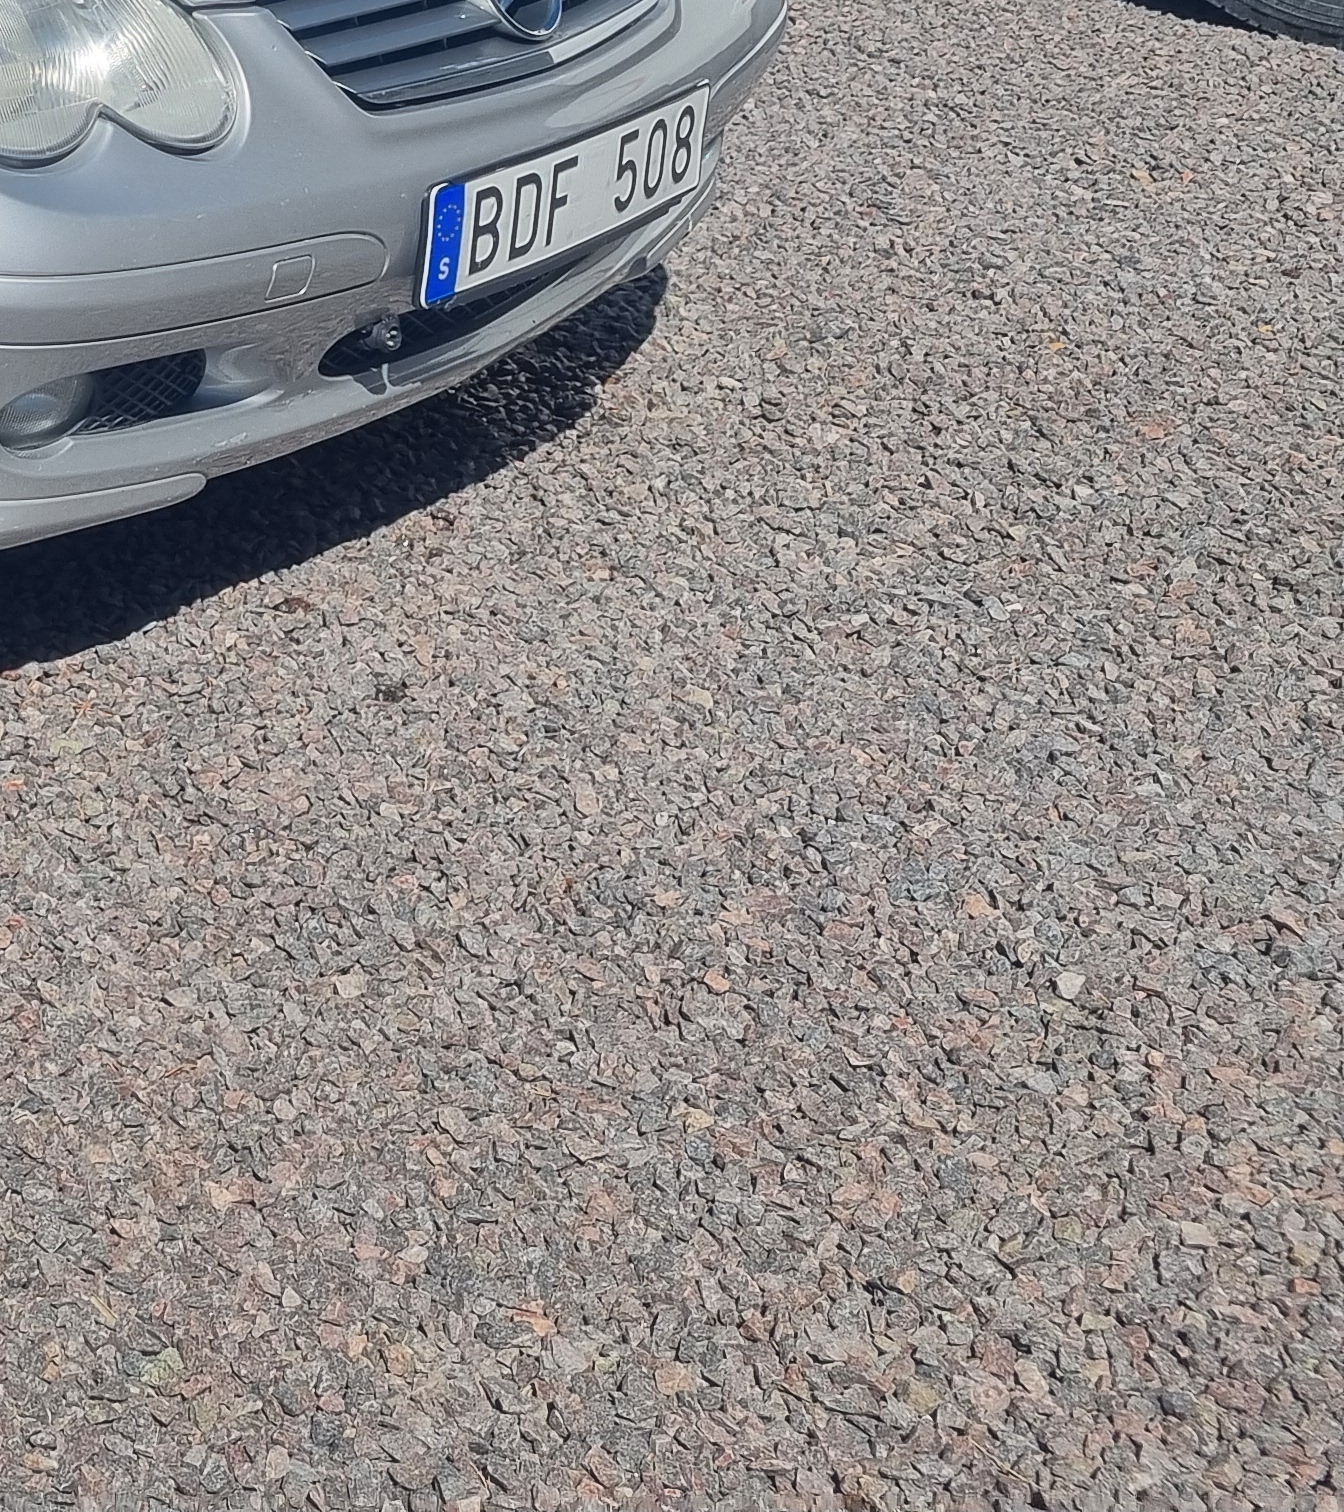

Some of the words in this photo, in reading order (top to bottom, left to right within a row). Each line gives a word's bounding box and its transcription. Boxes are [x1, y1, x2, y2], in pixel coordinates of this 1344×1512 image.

[468, 155, 579, 276] BDF
[614, 105, 696, 213] 508
[438, 257, 451, 280] S
